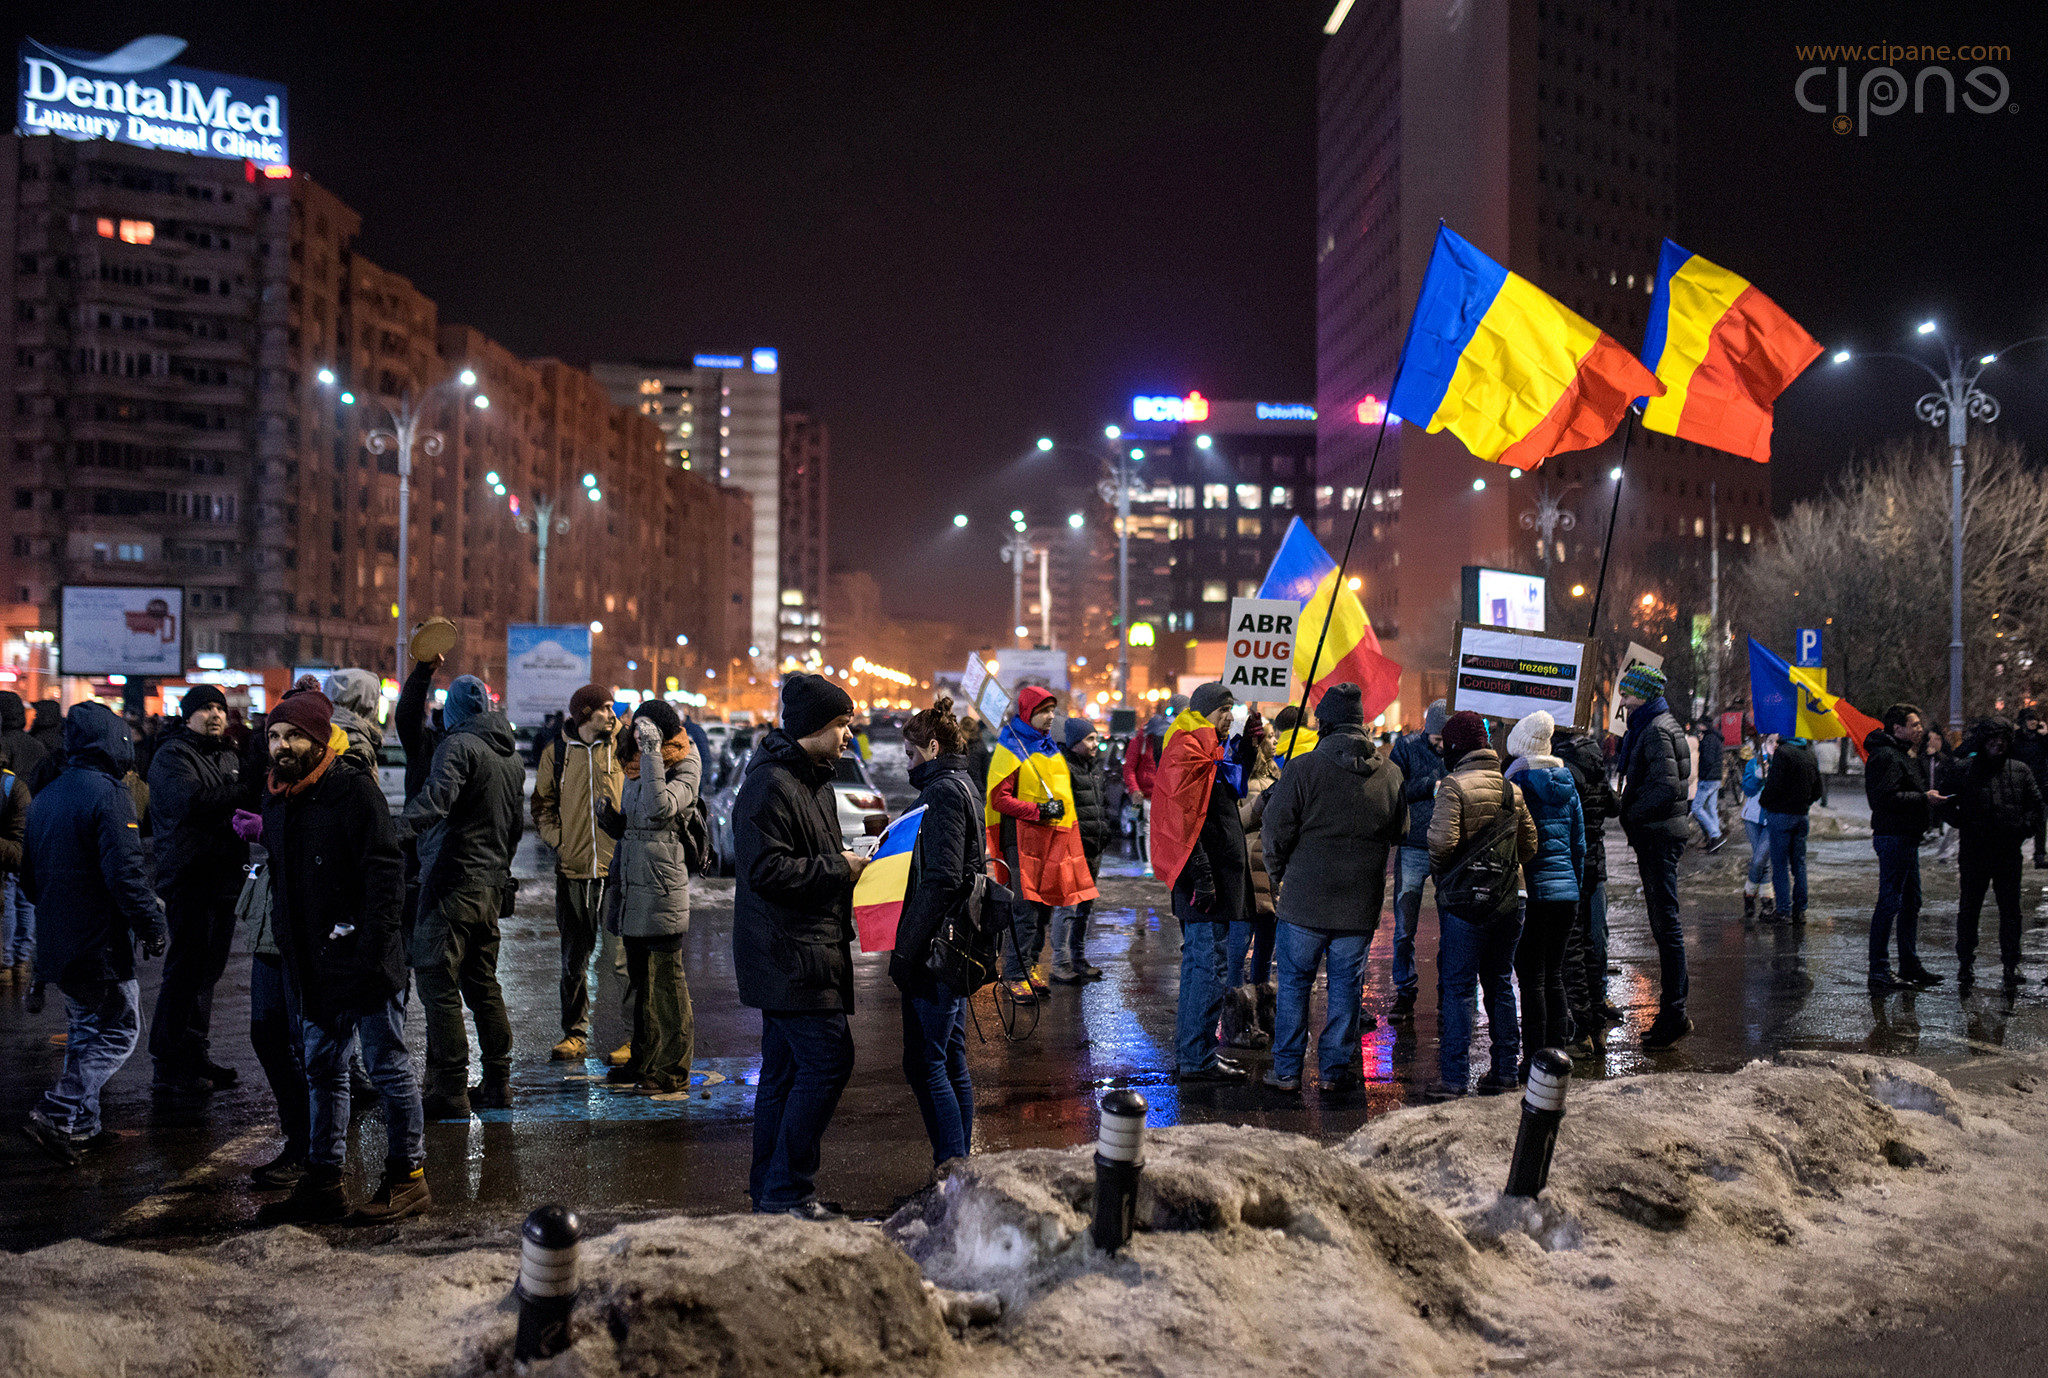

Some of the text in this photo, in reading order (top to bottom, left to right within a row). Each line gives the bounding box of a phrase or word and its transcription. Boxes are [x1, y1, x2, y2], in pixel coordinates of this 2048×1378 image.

[24, 56, 284, 138] DentalMed
[25, 101, 284, 163] Luxury Dental Clinic
[1237, 613, 1293, 635] ABR
[1233, 639, 1291, 661] OUG
[1802, 629, 1817, 662] P
[1230, 665, 1288, 687] ARE
